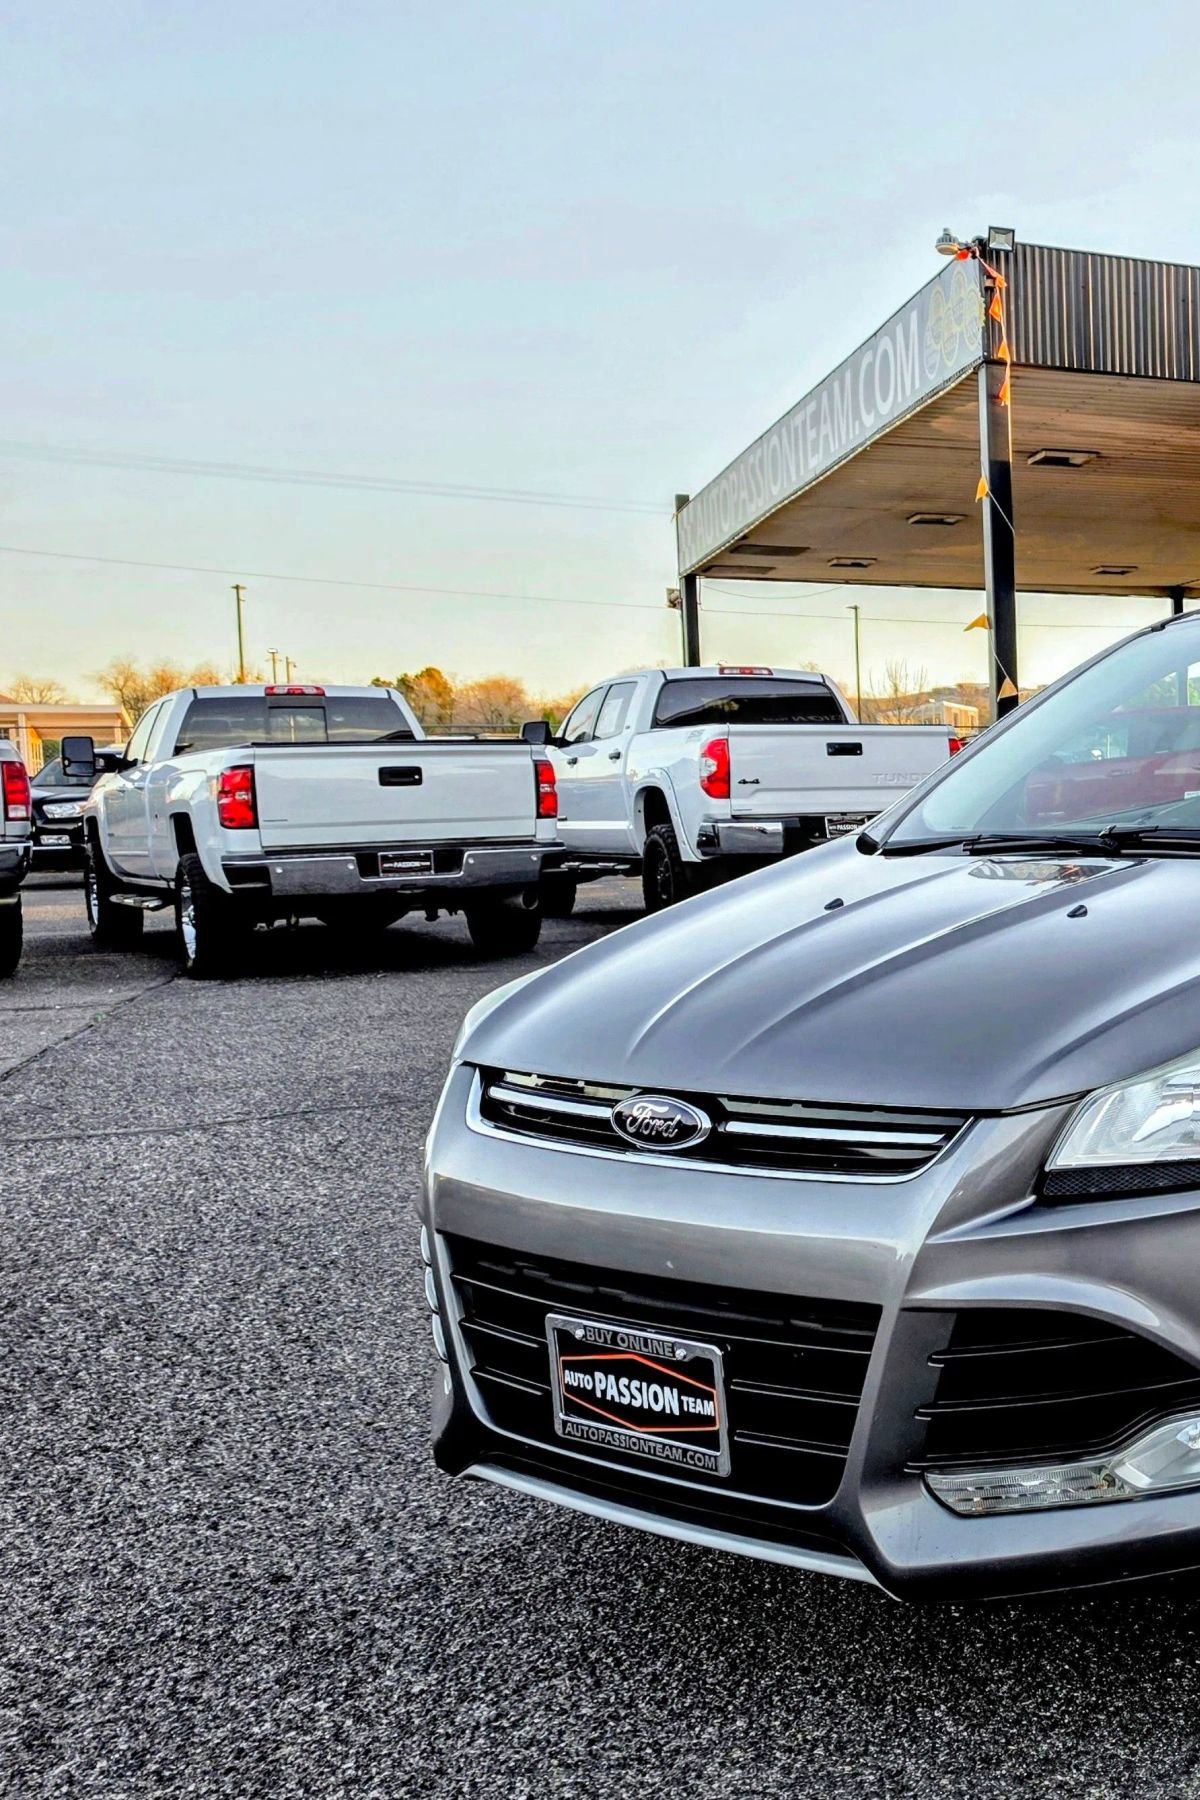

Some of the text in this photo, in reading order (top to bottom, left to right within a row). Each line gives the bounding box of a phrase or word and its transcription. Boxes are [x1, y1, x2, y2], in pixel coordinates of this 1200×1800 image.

[697, 309, 920, 548] AUTOPASSIONTEAM.COM
[626, 1102, 681, 1138] Ford
[585, 1327, 673, 1357] BUY ONLINE
[564, 1369, 715, 1417] AUTO PASSION TEAM
[565, 1422, 716, 1470] AUTOPASSIONTEAM.COM
